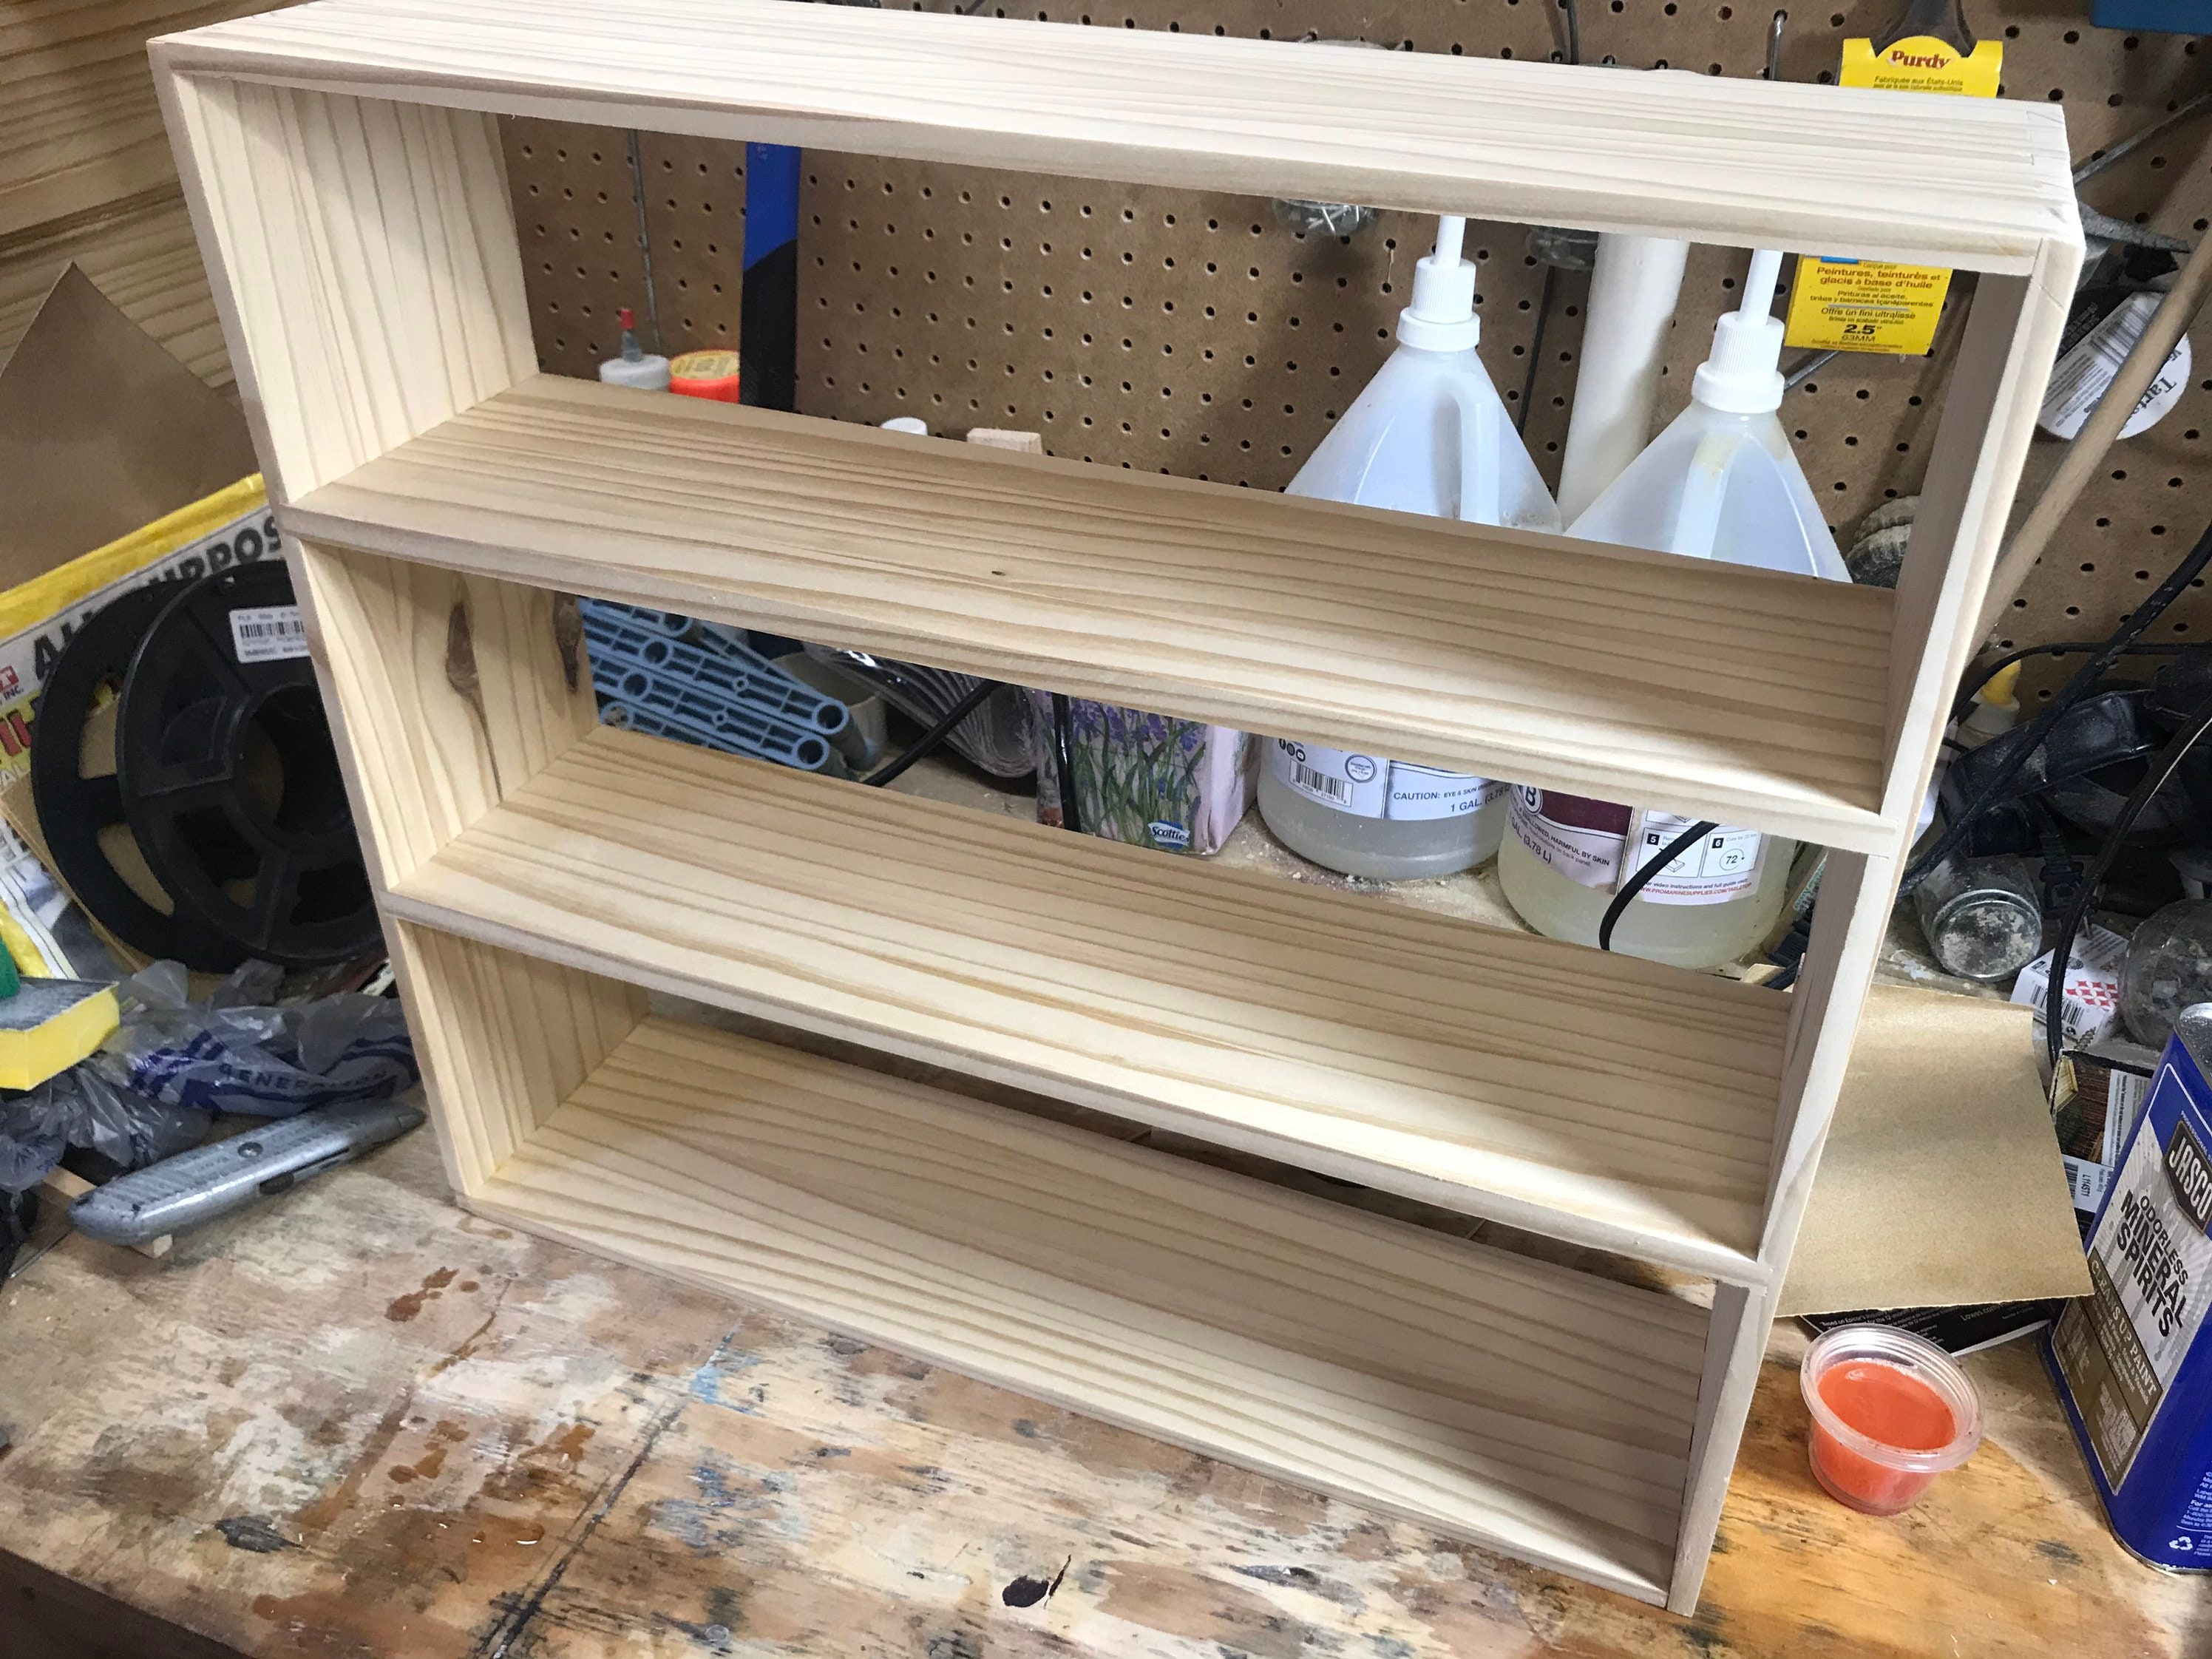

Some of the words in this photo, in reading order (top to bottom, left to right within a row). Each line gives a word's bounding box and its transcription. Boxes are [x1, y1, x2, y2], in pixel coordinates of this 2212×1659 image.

[1892, 50, 1951, 69] Purdy
[1816, 266, 1873, 278] Peintures,
[1820, 276, 1853, 286] glacis
[1864, 278, 1893, 286] base
[1896, 280, 1933, 289] d'huile
[1821, 307, 1843, 316] Offre
[1859, 309, 1873, 317] fini
[1844, 324, 1882, 335] 2.5"
[3, 685, 25, 702] INC.
[1394, 792, 1441, 800] CAUTION:
[1463, 787, 1477, 795] SKIN
[1451, 804, 1456, 812] 1
[1459, 798, 1482, 811] GAL.
[1485, 787, 1504, 804] (3.78
[1151, 826, 1190, 842] Scotties
[1523, 833, 1541, 855] (3.78
[1542, 849, 1552, 864] L)
[1550, 836, 1581, 855] HARMFUL
[1581, 851, 1592, 859] BY
[1592, 855, 1610, 866] SKIN
[1726, 855, 1738, 865] 72
[2168, 1136, 2212, 1220] JASCO
[2140, 1195, 2188, 1286] ODORLESS
[2120, 1189, 2187, 1329] MINERAL
[2117, 1221, 2174, 1337] SPIRITS
[2091, 1260, 2122, 1321] CLEANS
[2118, 1317, 2133, 1343] UP
[2129, 1342, 2157, 1396] PAINT
